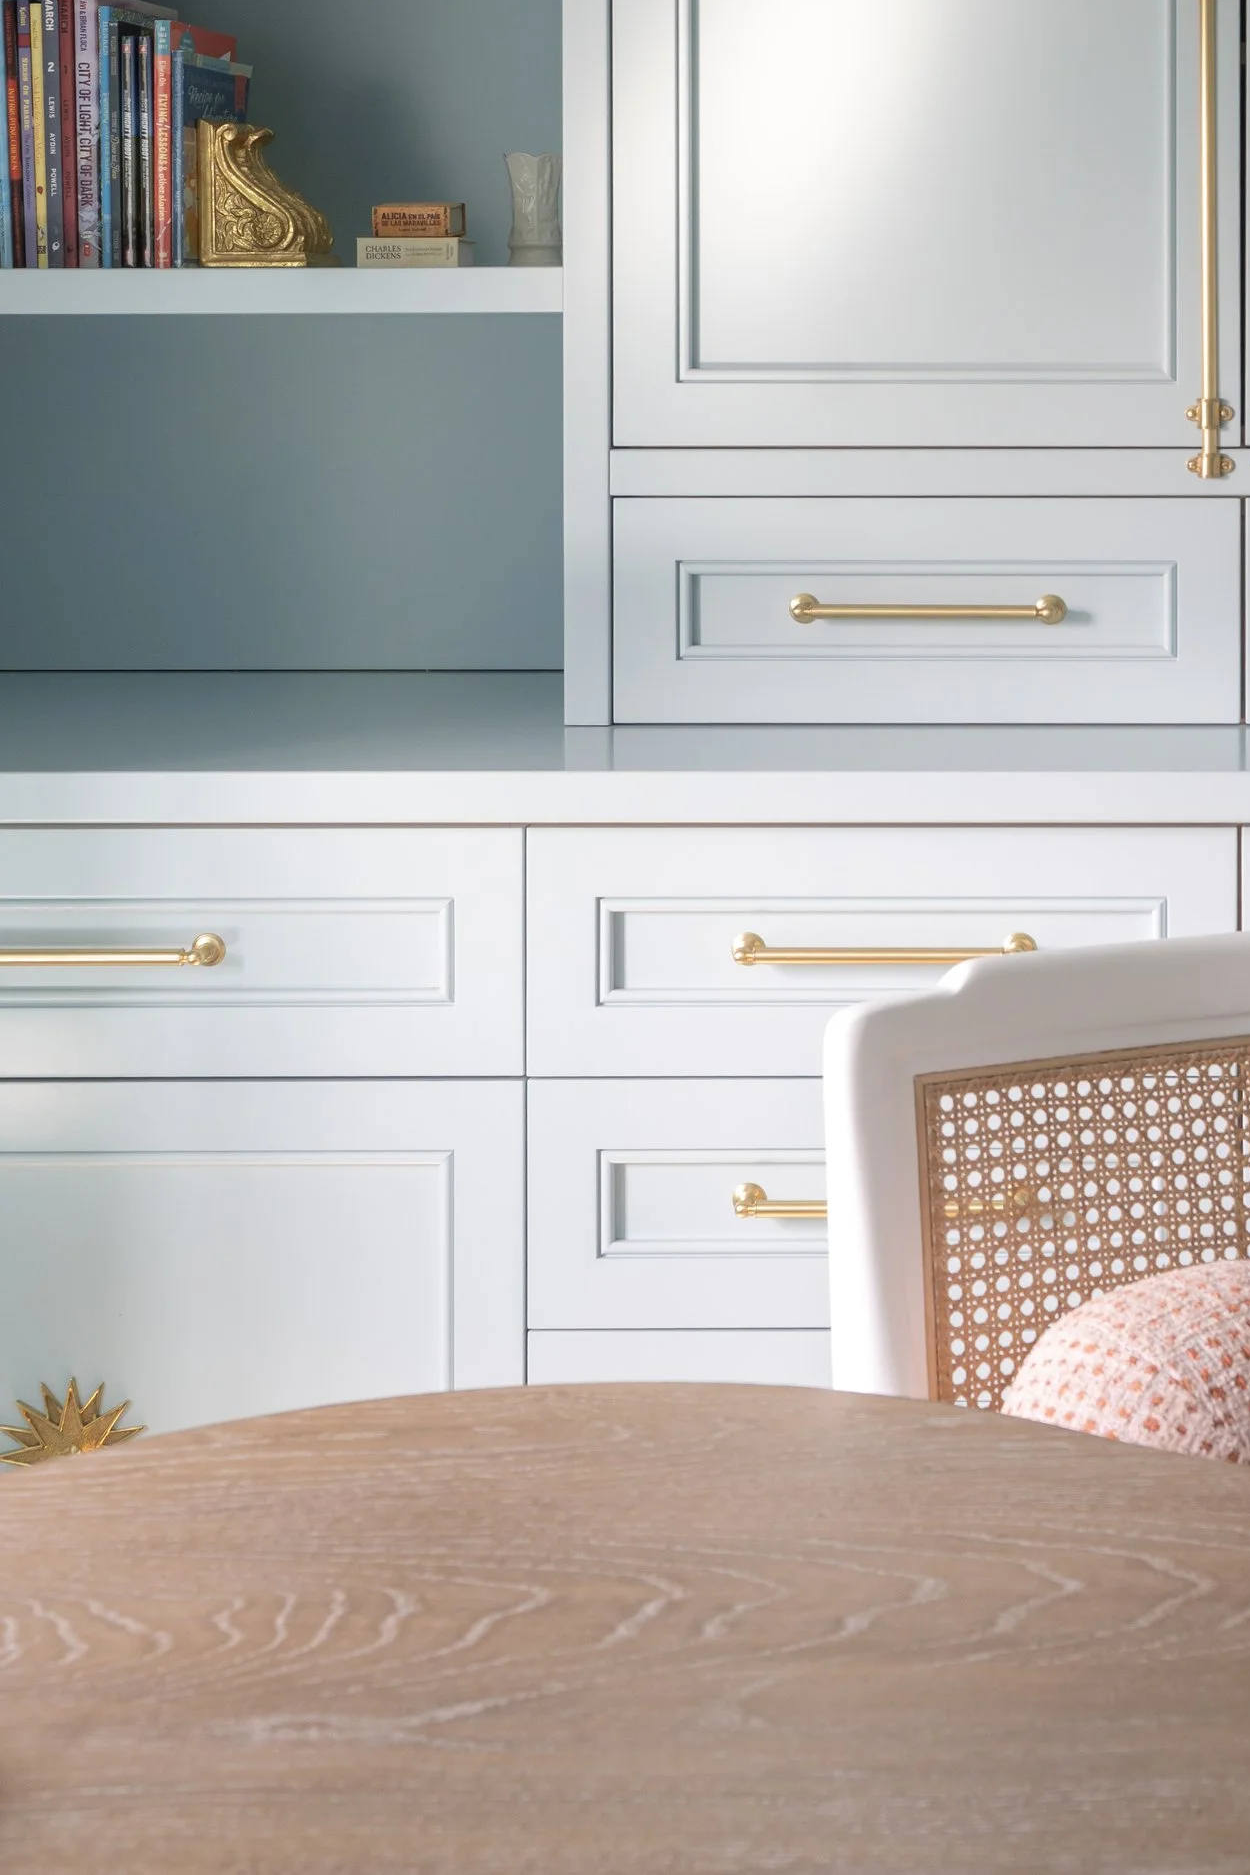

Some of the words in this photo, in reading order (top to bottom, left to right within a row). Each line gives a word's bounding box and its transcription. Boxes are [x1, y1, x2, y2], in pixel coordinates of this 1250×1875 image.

[60, 0, 69, 34] MARCH
[80, 33, 88, 52] FLOCA
[47, 61, 55, 73] 2
[78, 62, 91, 86] CITY
[79, 88, 91, 102] OF
[158, 93, 168, 123] FLYING
[80, 137, 92, 161] CITY
[157, 127, 168, 165] LESSONS
[80, 164, 92, 177] OF
[80, 180, 93, 207] DARK
[158, 173, 167, 194] other
[381, 212, 407, 220] ALICIA
